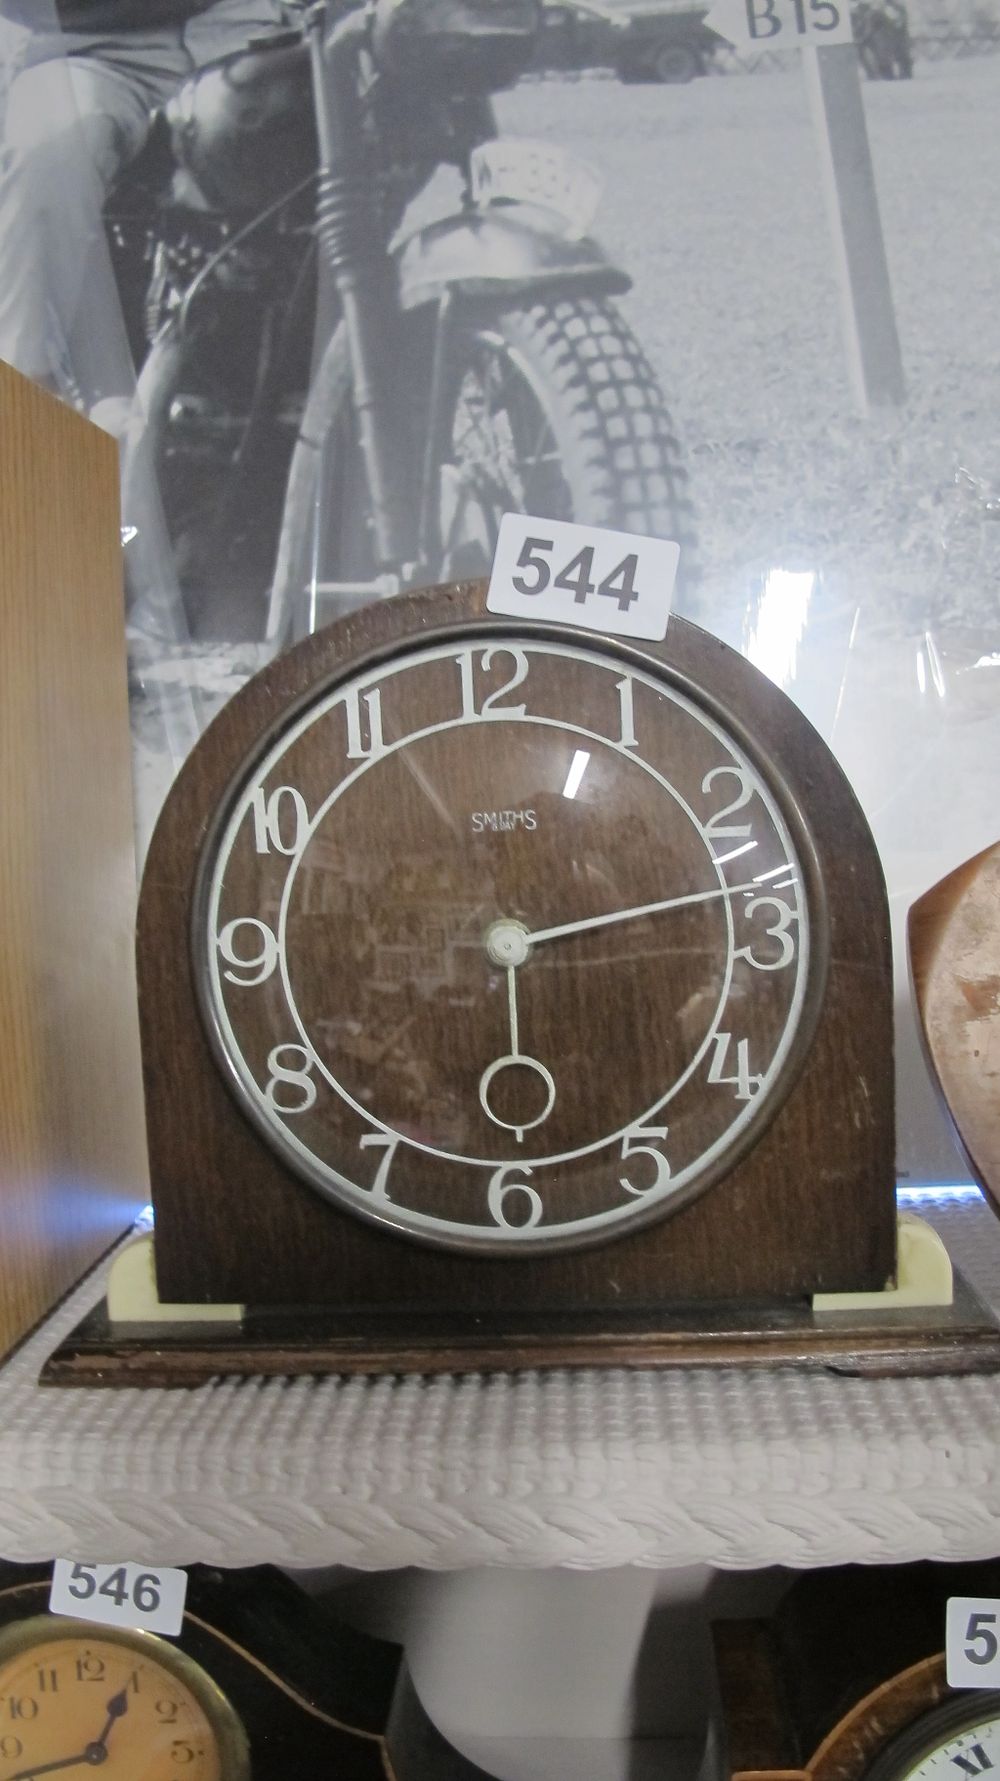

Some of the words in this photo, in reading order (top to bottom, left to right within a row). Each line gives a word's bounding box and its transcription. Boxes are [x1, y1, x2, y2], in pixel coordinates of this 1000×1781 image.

[511, 536, 639, 611] 544
[456, 648, 529, 720] 12
[616, 676, 638, 748] 1
[344, 687, 387, 759] 11
[252, 786, 309, 855] 10
[471, 808, 537, 833] SMITHS
[702, 766, 752, 838] 2
[217, 918, 279, 986] 9
[737, 896, 798, 971] 3
[265, 1044, 317, 1114] 8
[707, 1032, 764, 1100] 4
[359, 1134, 399, 1201] 7
[620, 1127, 670, 1196] 5
[488, 1167, 543, 1229] 6
[68, 1563, 161, 1612] 546
[38, 1670, 58, 1692] 11
[75, 1657, 105, 1681] 12
[10, 1697, 38, 1720] 10
[155, 1700, 177, 1724] 2
